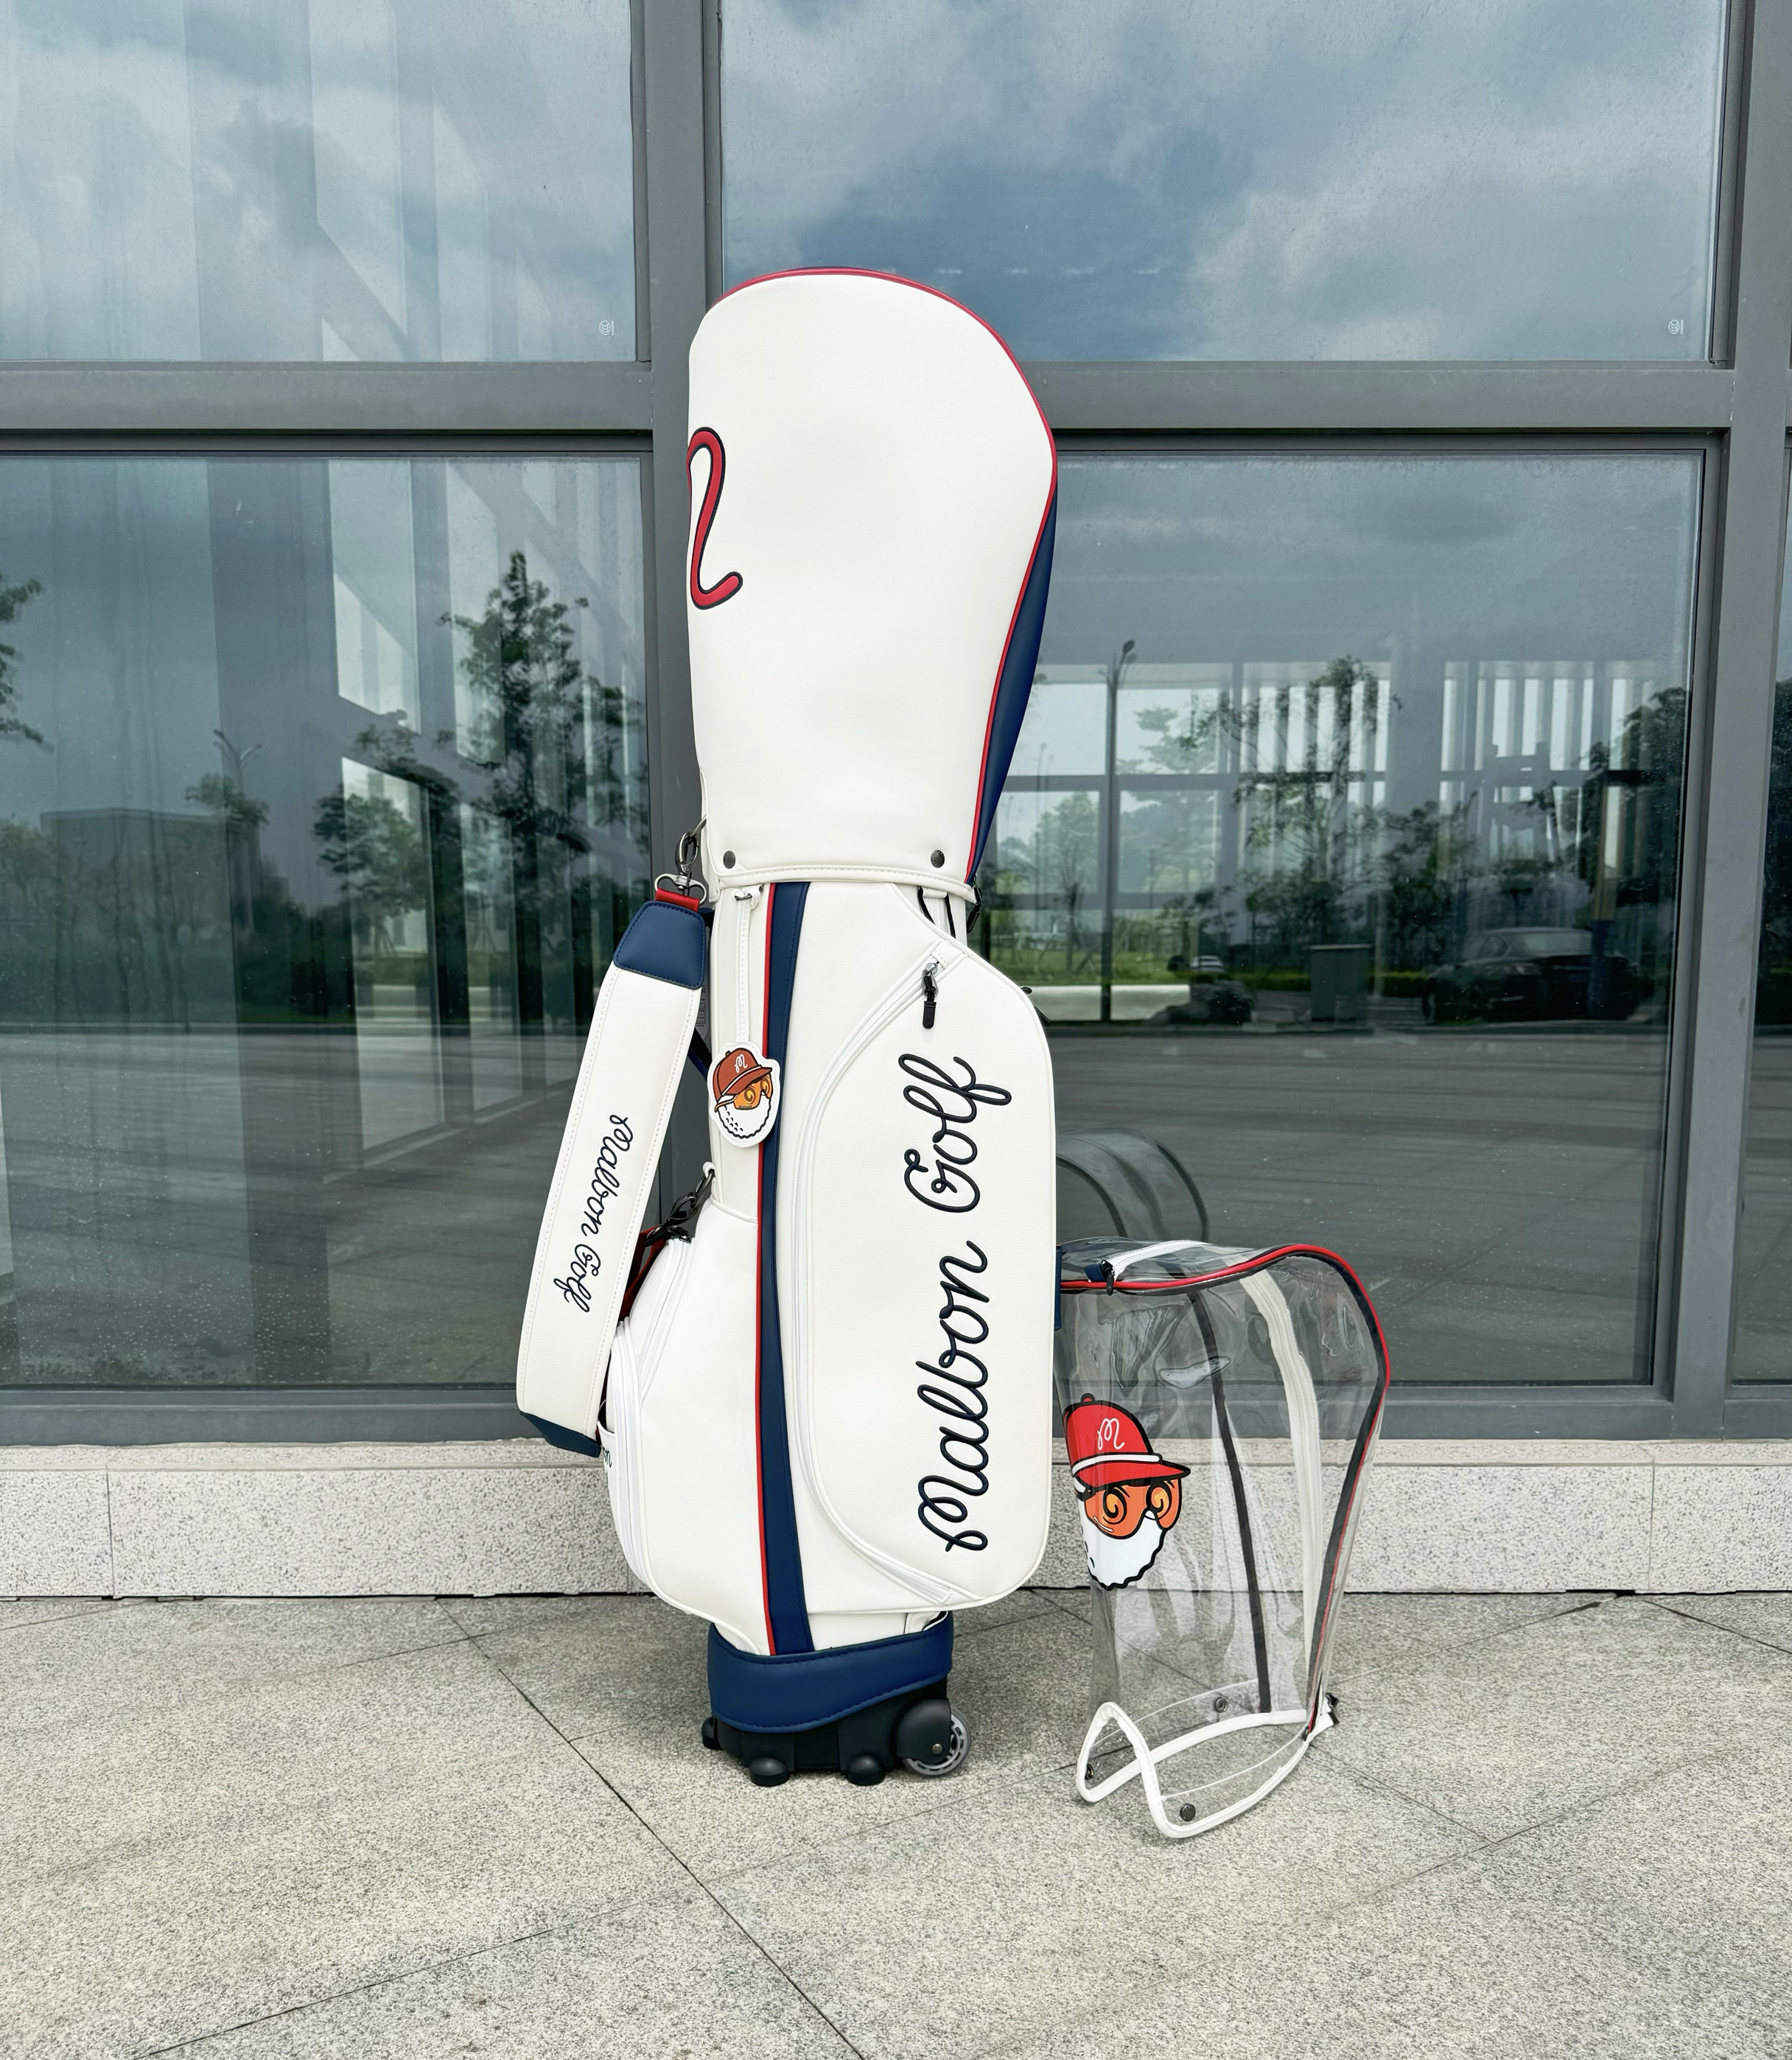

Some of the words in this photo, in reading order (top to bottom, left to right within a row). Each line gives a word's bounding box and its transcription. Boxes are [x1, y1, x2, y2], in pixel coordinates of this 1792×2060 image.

[735, 1054, 749, 1073] M
[581, 1114, 634, 1237] Malbon
[897, 1053, 1012, 1213] Golf
[553, 1244, 601, 1313] Golf
[915, 1240, 990, 1552] Malbon
[1096, 1418, 1125, 1451] M
